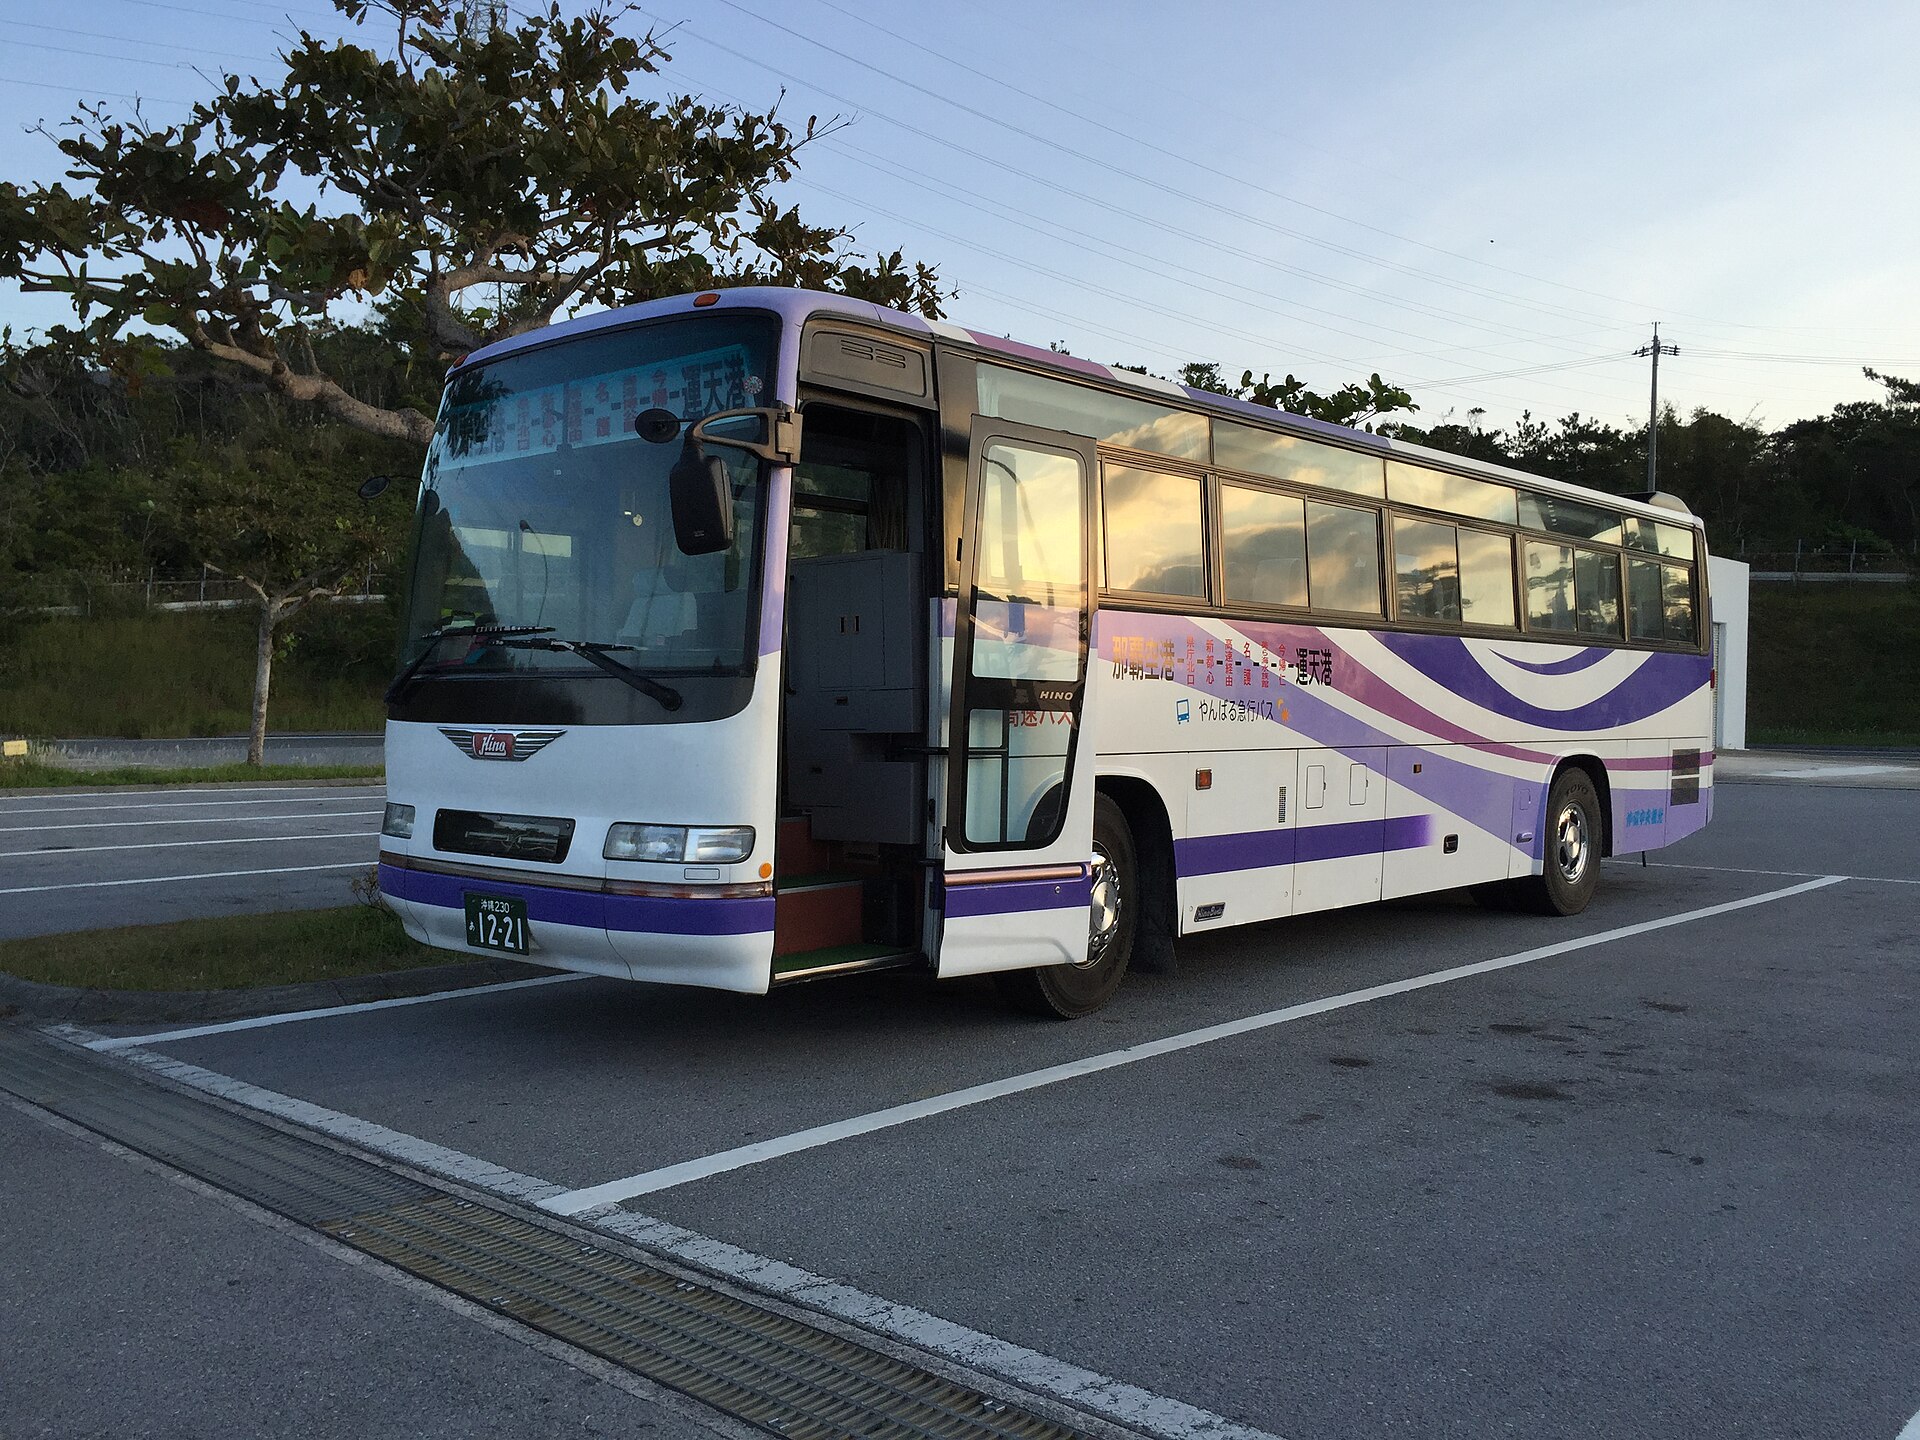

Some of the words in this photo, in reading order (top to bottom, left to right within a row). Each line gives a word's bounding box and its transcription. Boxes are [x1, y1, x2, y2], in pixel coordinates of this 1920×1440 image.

[1111, 635, 1175, 681] 那覇空港
[1186, 636, 1195, 686] 県庁北口
[1205, 639, 1215, 685] 新都心
[1224, 638, 1233, 687] 高速経由
[1242, 641, 1252, 686] 名護
[1277, 643, 1287, 687] 今帰仁
[1295, 647, 1333, 687] 運天港
[1039, 690, 1074, 701] HINO
[1198, 699, 1275, 722] やんばる急行バス
[478, 733, 507, 756] Hino
